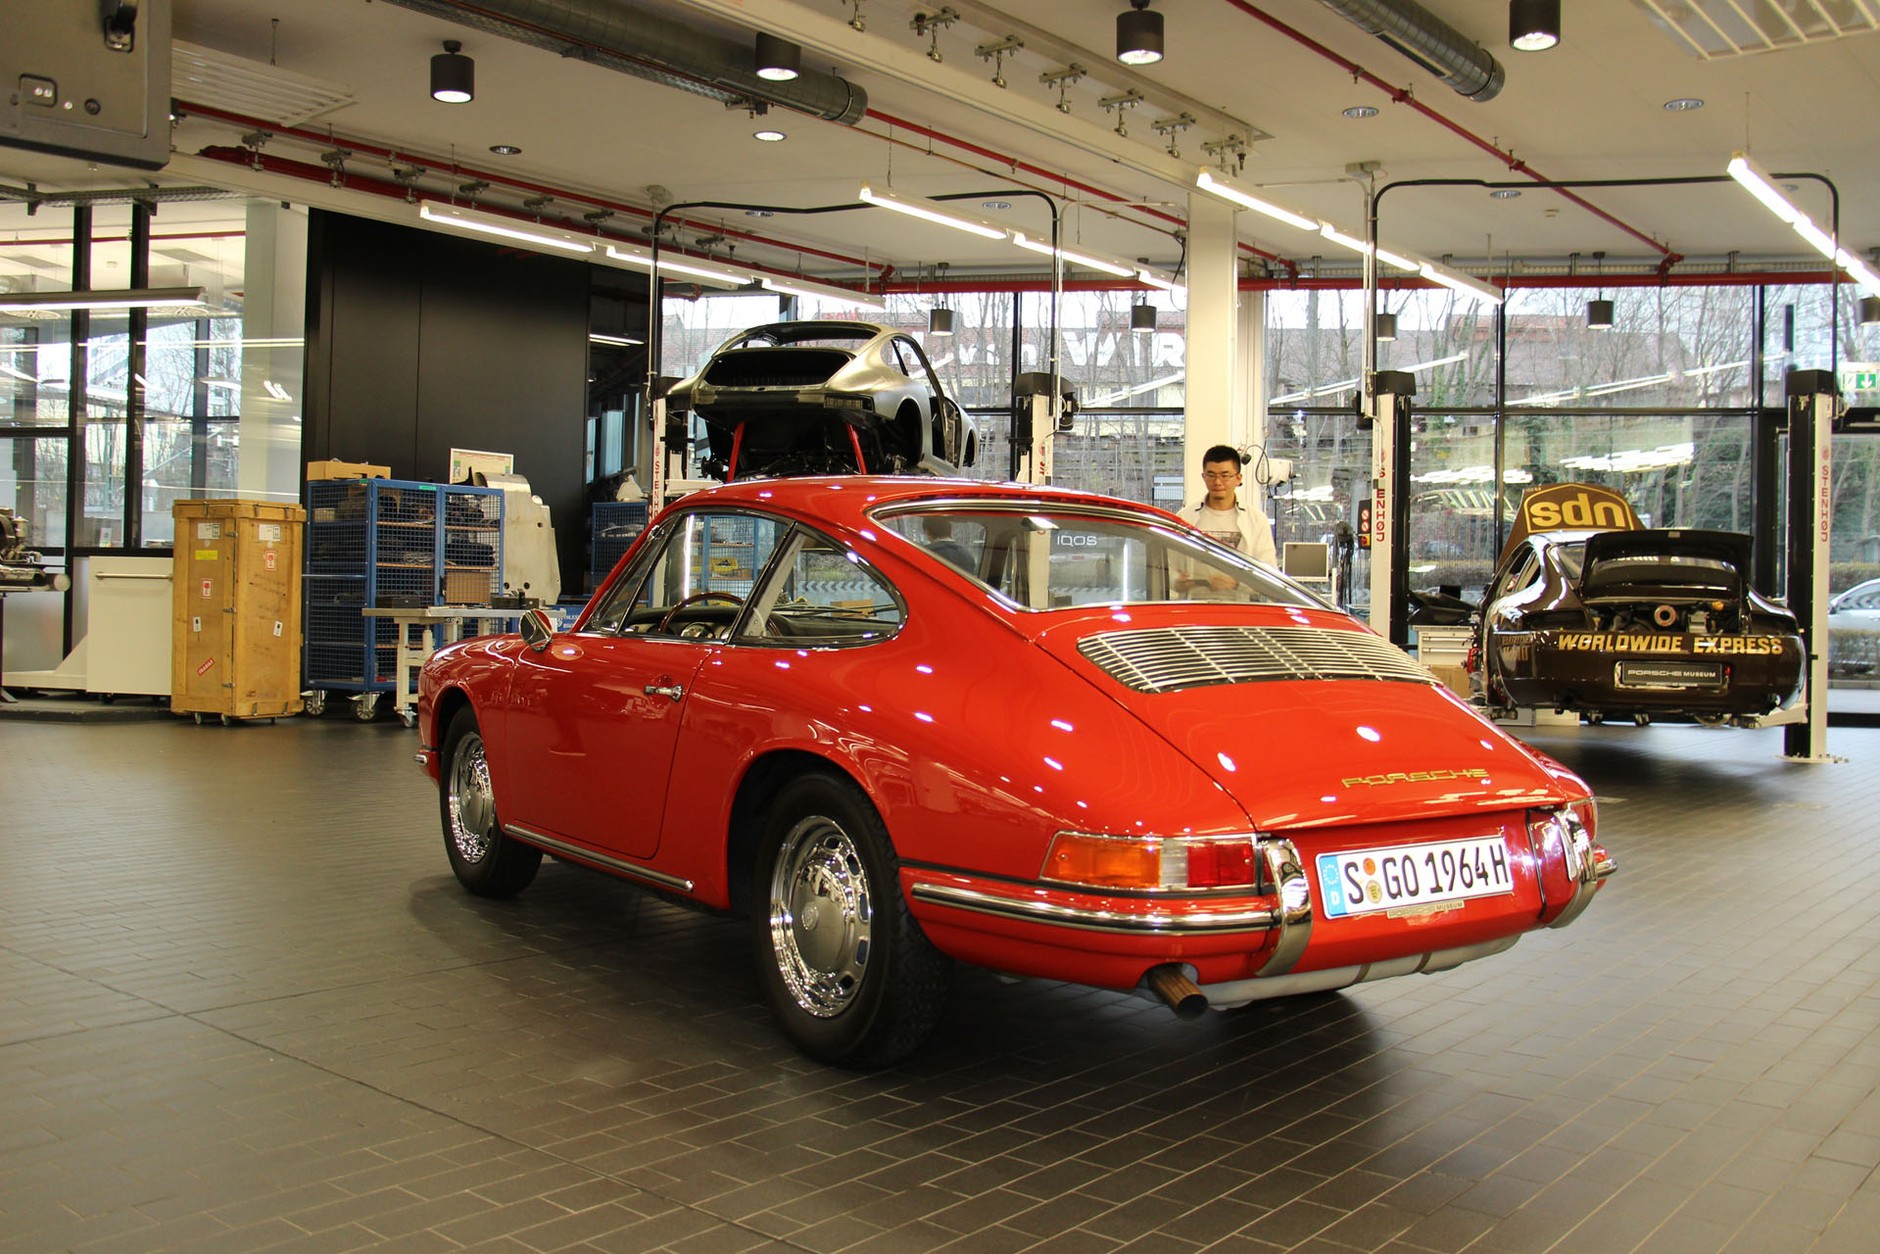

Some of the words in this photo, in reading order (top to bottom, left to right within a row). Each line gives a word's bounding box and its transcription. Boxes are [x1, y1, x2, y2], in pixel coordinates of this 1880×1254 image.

[1376, 468, 1385, 542] SENHØJ
[1057, 535, 1097, 546] IQOS
[1558, 634, 1683, 652] WORLDWIDE
[1693, 636, 1783, 655] EXPRESS
[1627, 669, 1683, 677] PORSCHE
[1341, 768, 1489, 788] PORSCHE
[1344, 861, 1365, 904] S
[1382, 853, 1420, 900] GO
[1424, 844, 1509, 894] 1964H
[1329, 890, 1341, 906] D
[1436, 901, 1463, 911] MUSEUM
